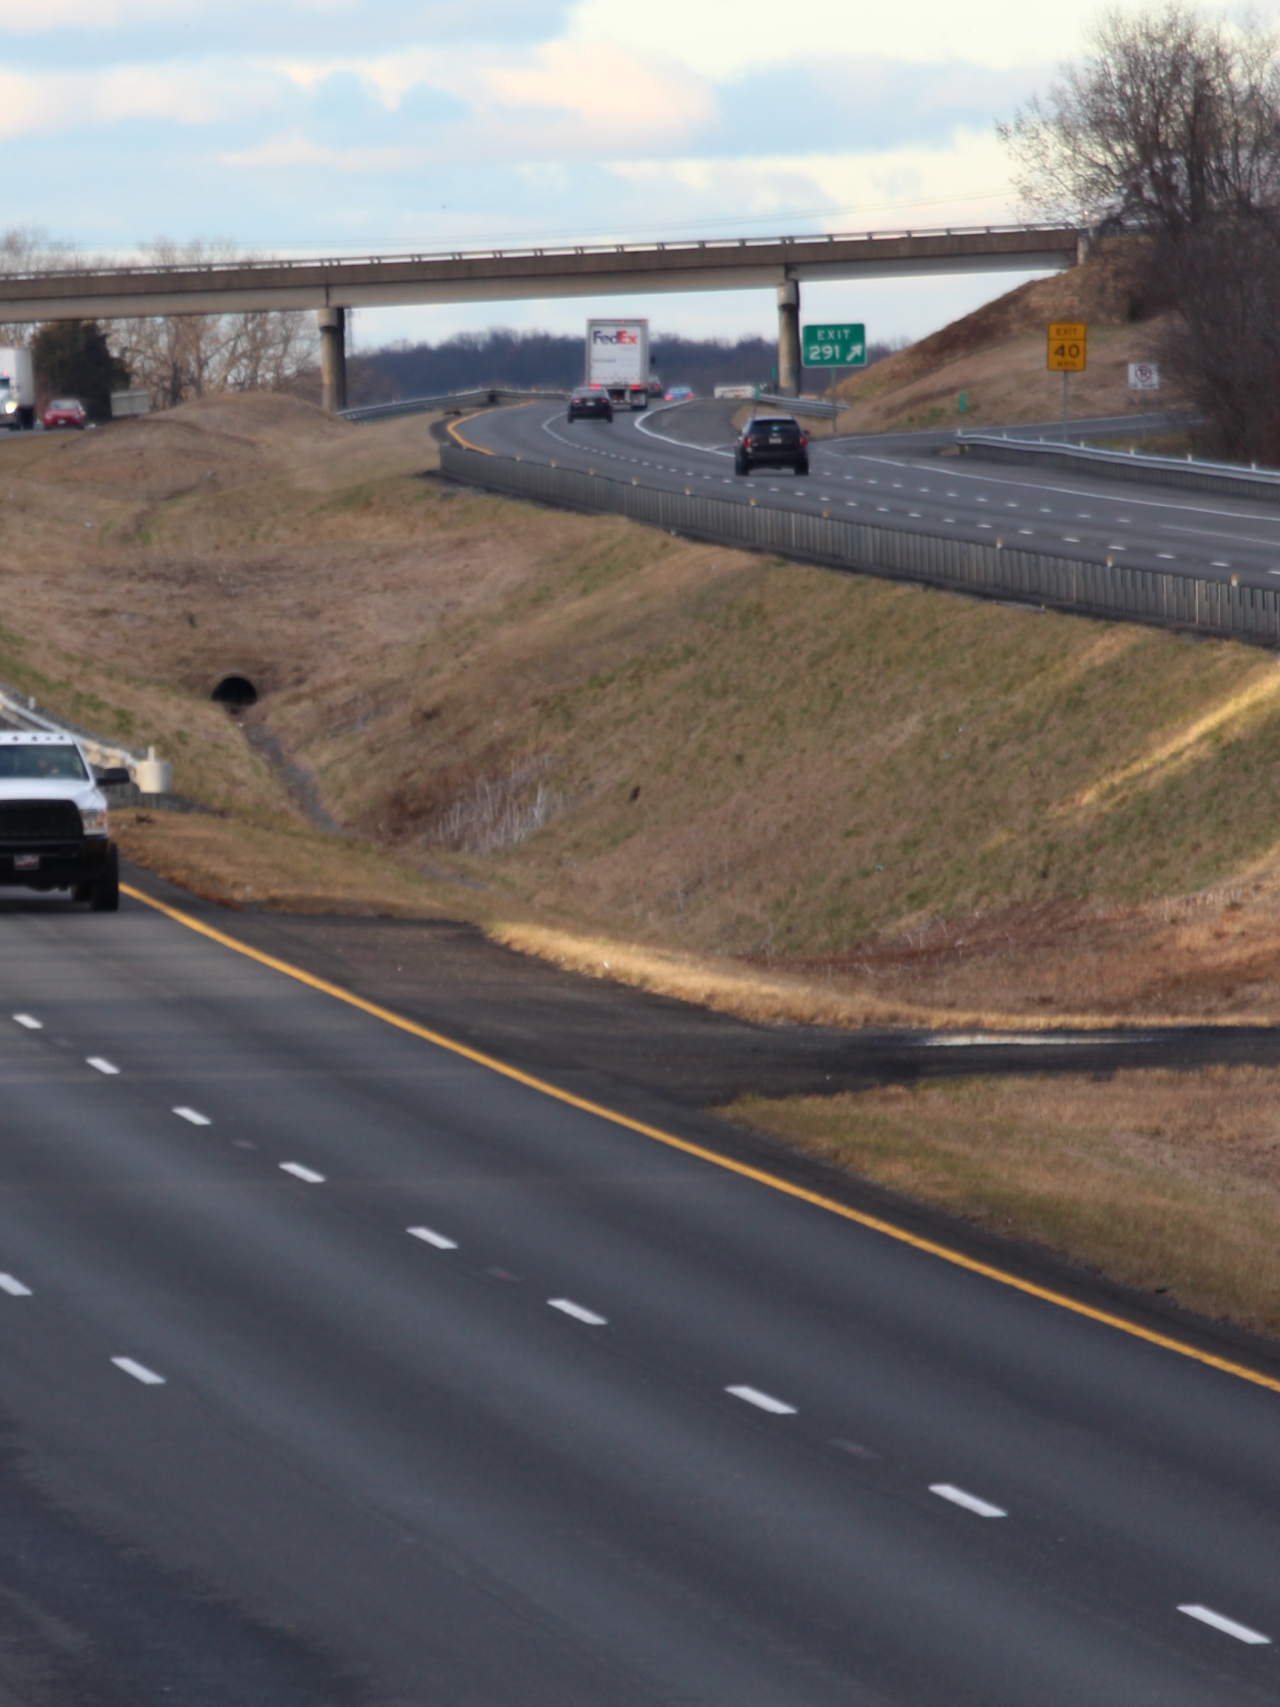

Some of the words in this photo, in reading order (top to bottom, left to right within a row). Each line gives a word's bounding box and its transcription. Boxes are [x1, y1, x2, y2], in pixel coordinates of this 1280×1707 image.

[593, 330, 639, 345] FedEx
[817, 329, 851, 341] EXIT
[809, 344, 840, 360] 291
[1054, 344, 1080, 359] 40
